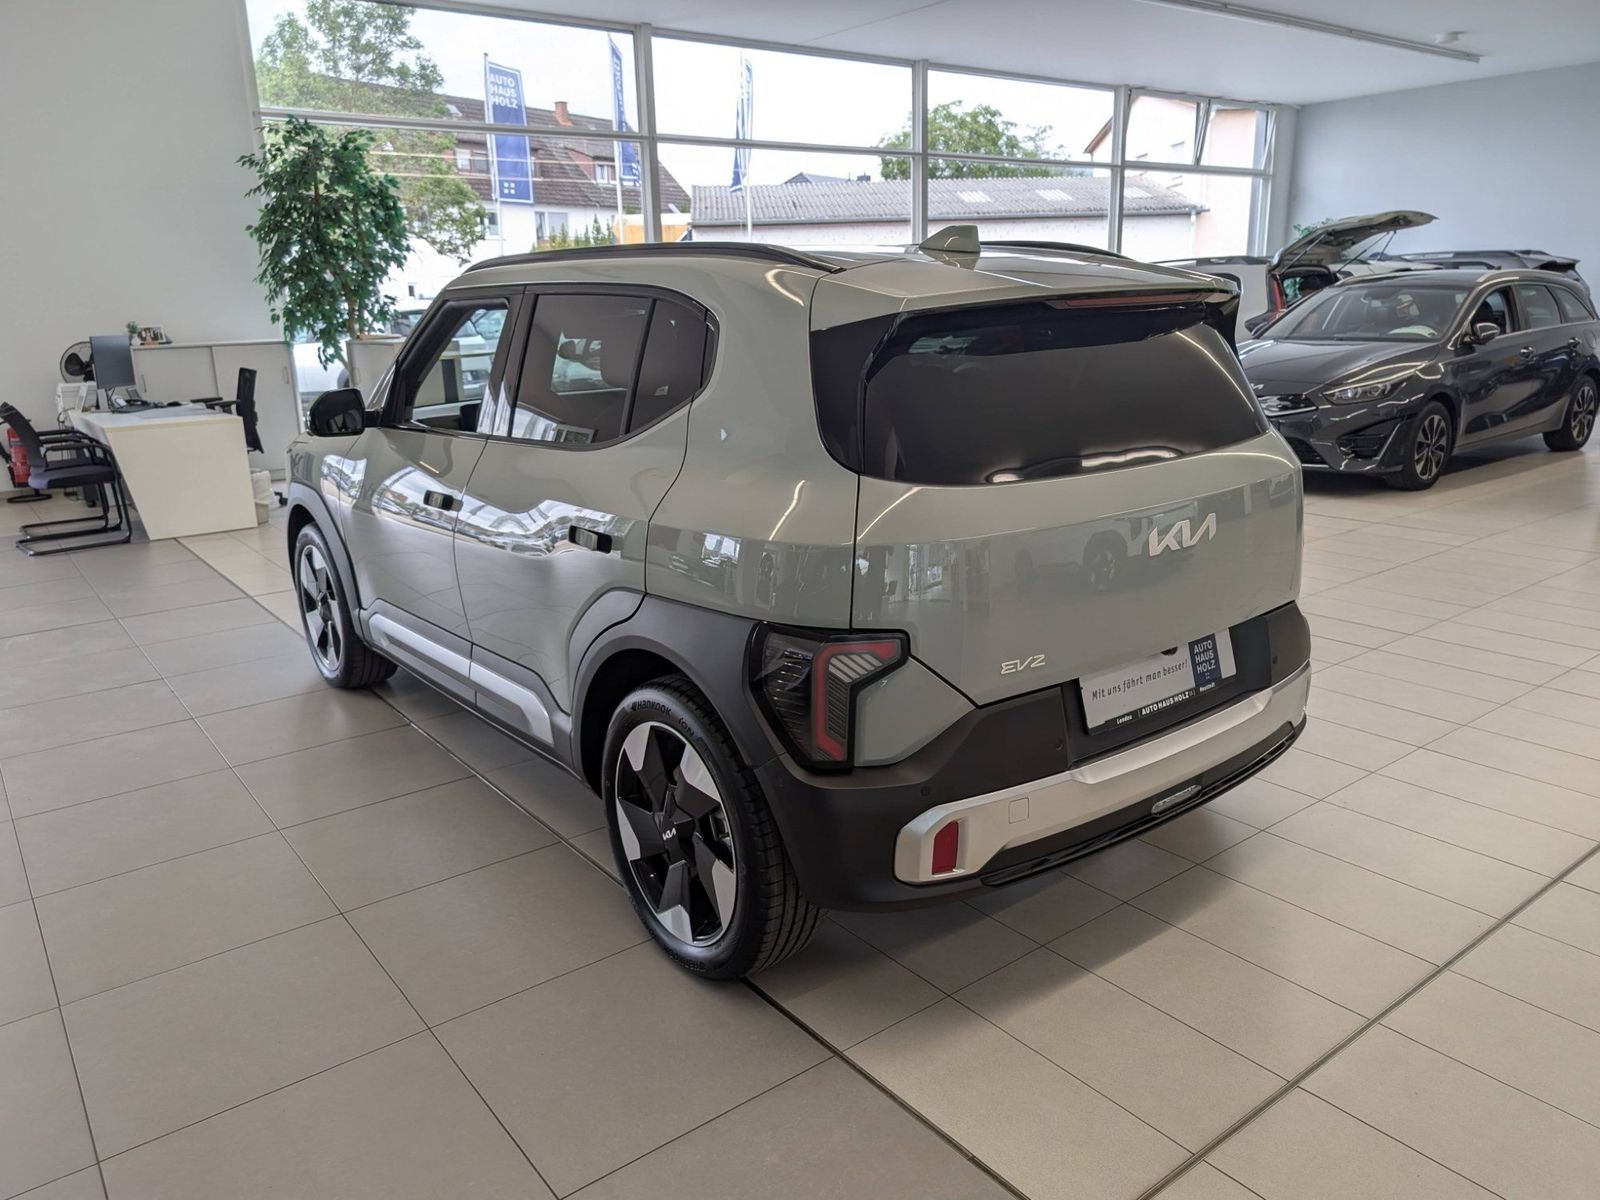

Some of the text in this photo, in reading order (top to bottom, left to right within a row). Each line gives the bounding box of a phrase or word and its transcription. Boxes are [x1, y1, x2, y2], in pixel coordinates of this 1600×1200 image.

[489, 73, 515, 87] AUTO
[490, 84, 517, 98] HAUS
[491, 95, 518, 109] HOLZ
[1149, 513, 1216, 557] KIA
[1194, 640, 1213, 654] AUTO
[1000, 654, 1045, 674] EV2
[1195, 650, 1214, 664] HAUS
[1197, 660, 1216, 674] HOLZ
[1092, 658, 1188, 701] Mit uns fährt man besser!
[1141, 704, 1158, 715] AUTO
[1158, 698, 1174, 709] HAUS
[1174, 691, 1190, 702] HOLZ
[662, 827, 677, 840] KIA
